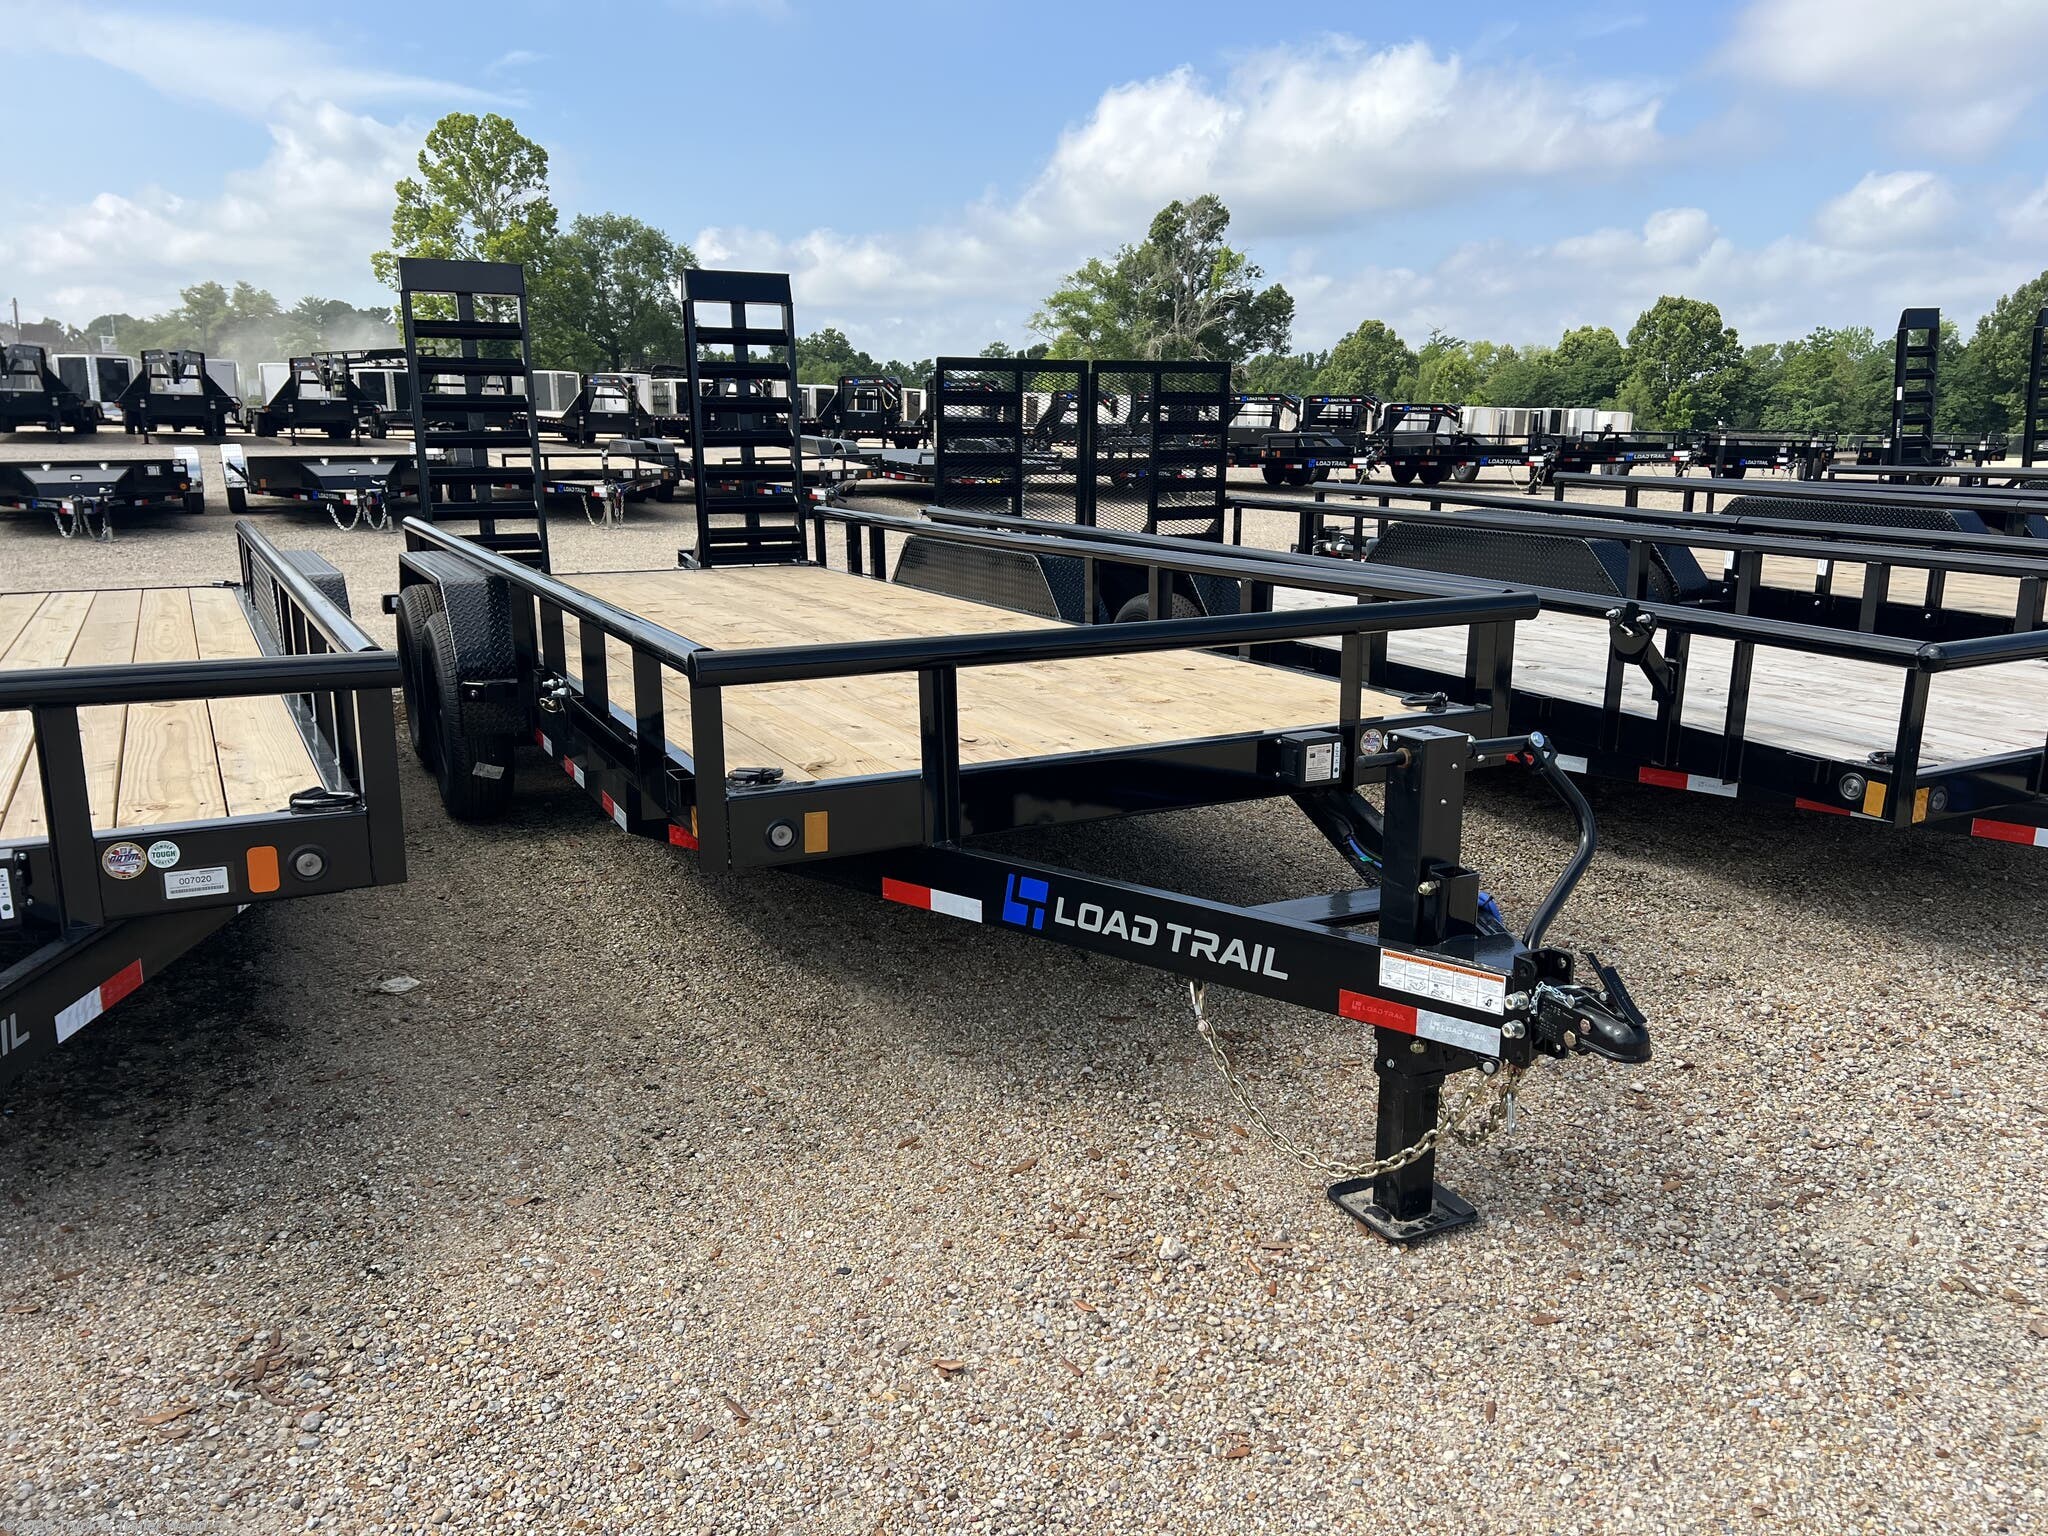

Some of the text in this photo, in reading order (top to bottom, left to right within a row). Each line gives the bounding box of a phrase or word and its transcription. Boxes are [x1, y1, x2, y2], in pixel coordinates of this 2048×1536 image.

[152, 850, 176, 859] TOUGH
[178, 875, 212, 886] 007020
[1054, 896, 1289, 981] LOAD TRAIL
